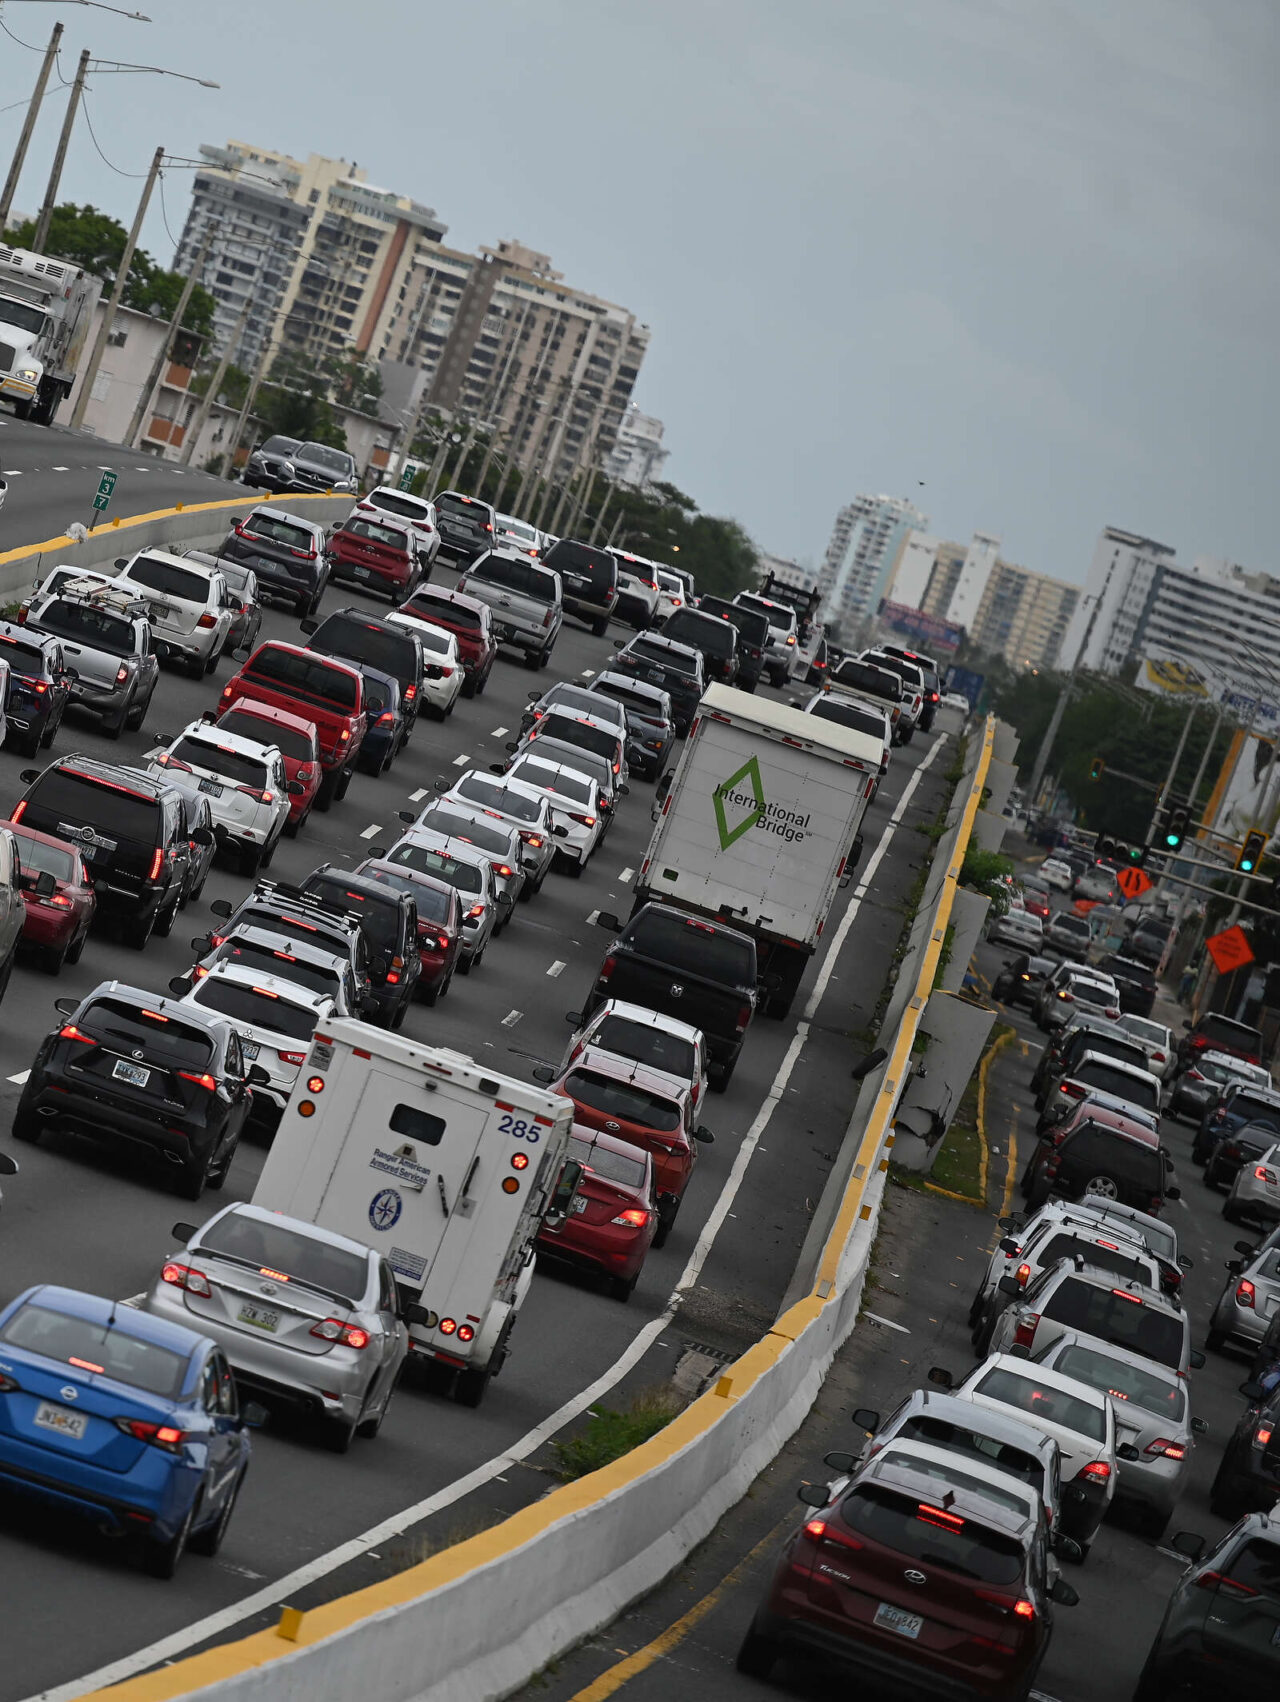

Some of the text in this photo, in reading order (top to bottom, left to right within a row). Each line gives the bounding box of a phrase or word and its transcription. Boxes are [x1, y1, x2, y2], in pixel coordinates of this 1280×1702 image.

[102, 483, 110, 494] 3
[103, 474, 116, 483] km
[714, 783, 811, 828] International
[756, 815, 804, 843] Bridge
[497, 1115, 542, 1144] 285
[370, 1157, 429, 1185] Armored Services
[373, 1148, 431, 1176] Ranger American
